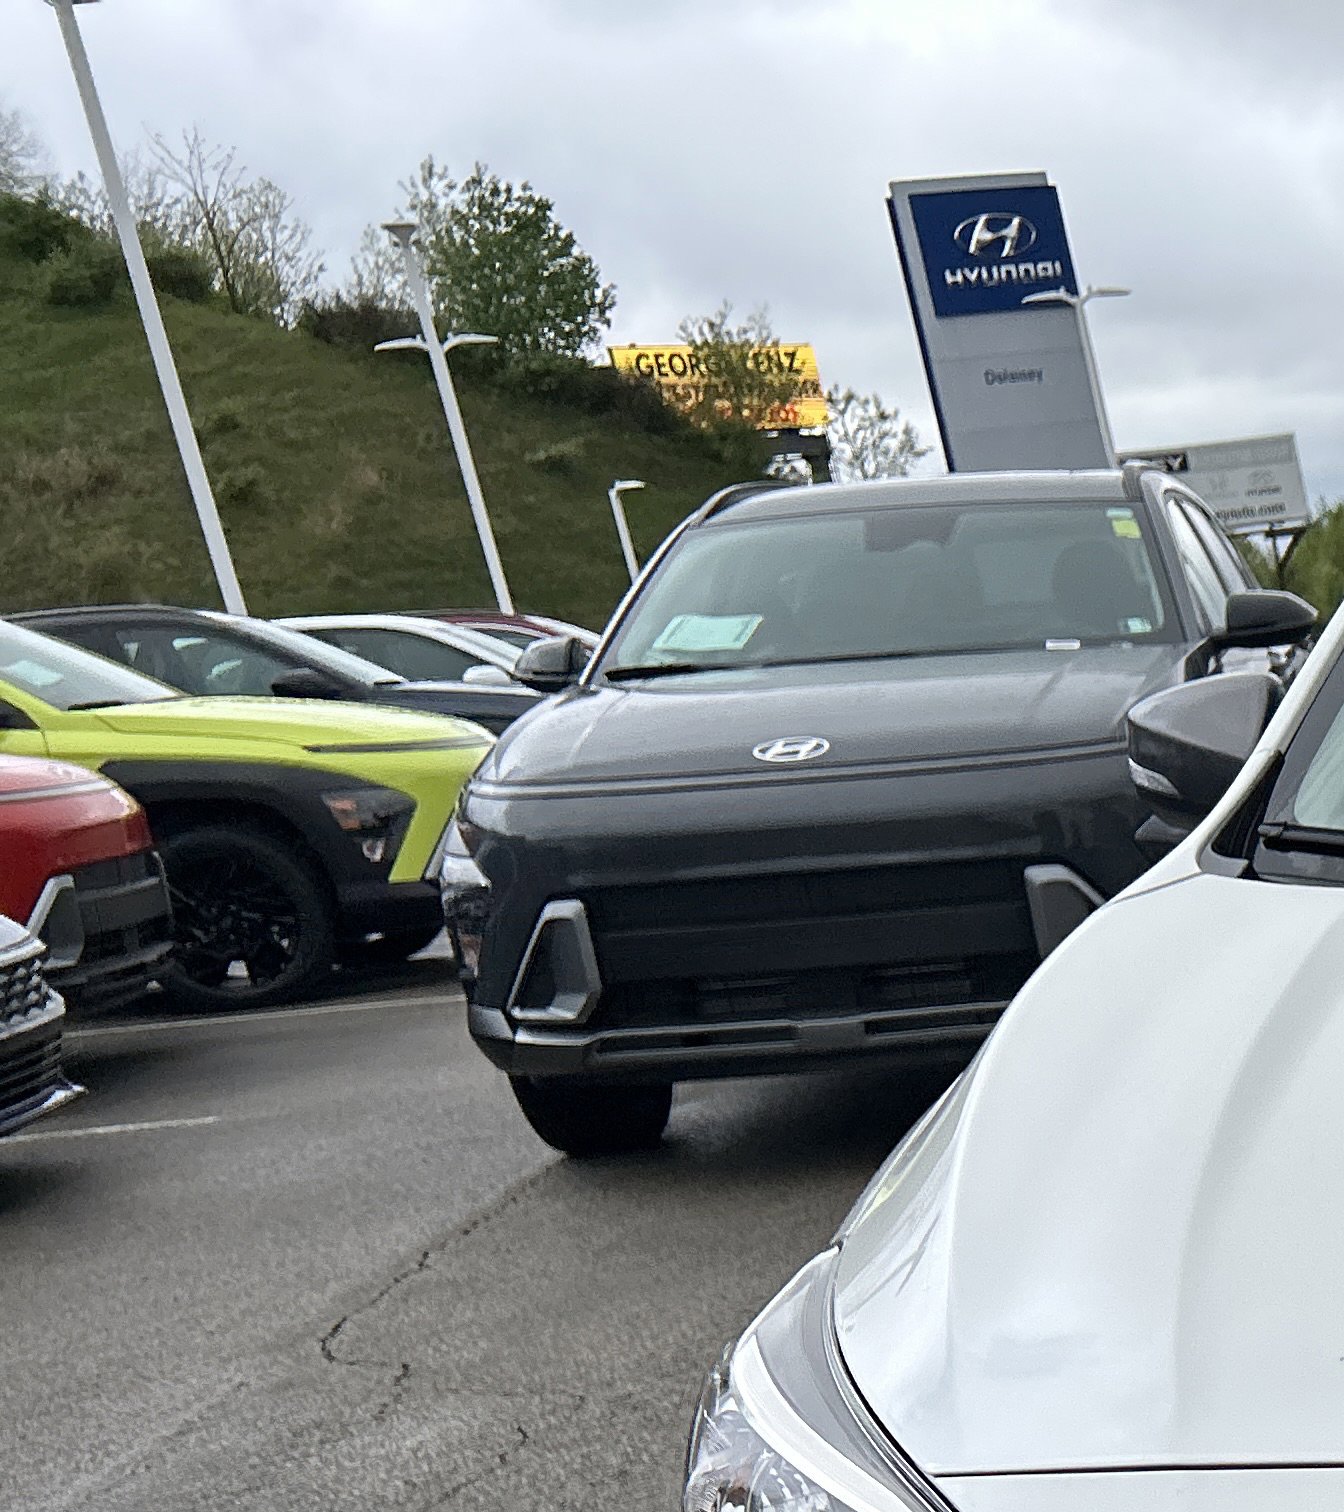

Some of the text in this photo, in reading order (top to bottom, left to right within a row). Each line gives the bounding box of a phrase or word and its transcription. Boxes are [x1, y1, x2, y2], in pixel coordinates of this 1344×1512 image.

[944, 261, 1063, 287] HYUNDAI
[635, 349, 803, 377] GEORG ENZ
